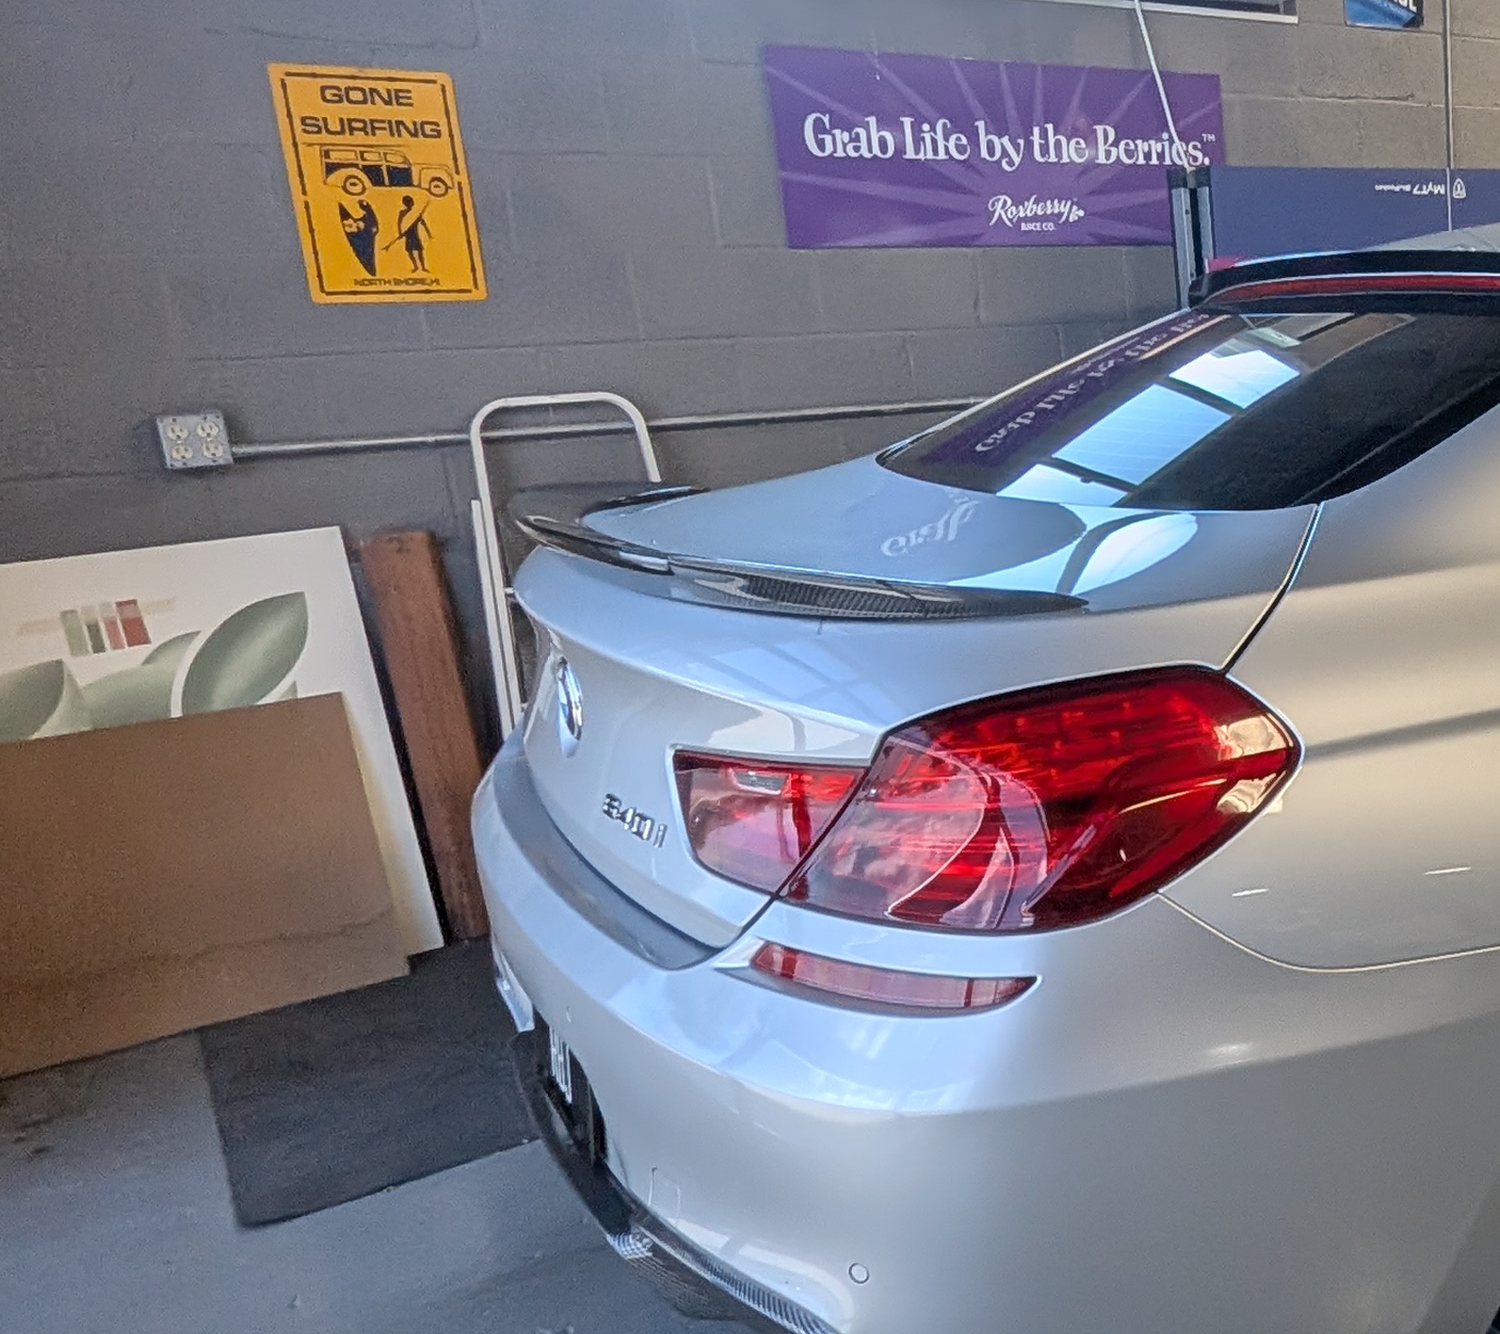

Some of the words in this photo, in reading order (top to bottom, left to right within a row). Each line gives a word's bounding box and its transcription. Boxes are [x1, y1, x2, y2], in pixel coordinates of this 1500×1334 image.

[320, 85, 414, 107] GONE
[301, 116, 442, 139] SURFING
[803, 112, 895, 159] Grab
[900, 116, 970, 161] Life
[974, 120, 1025, 172] by
[1029, 123, 1089, 163] the
[987, 194, 1072, 227] Roxberry
